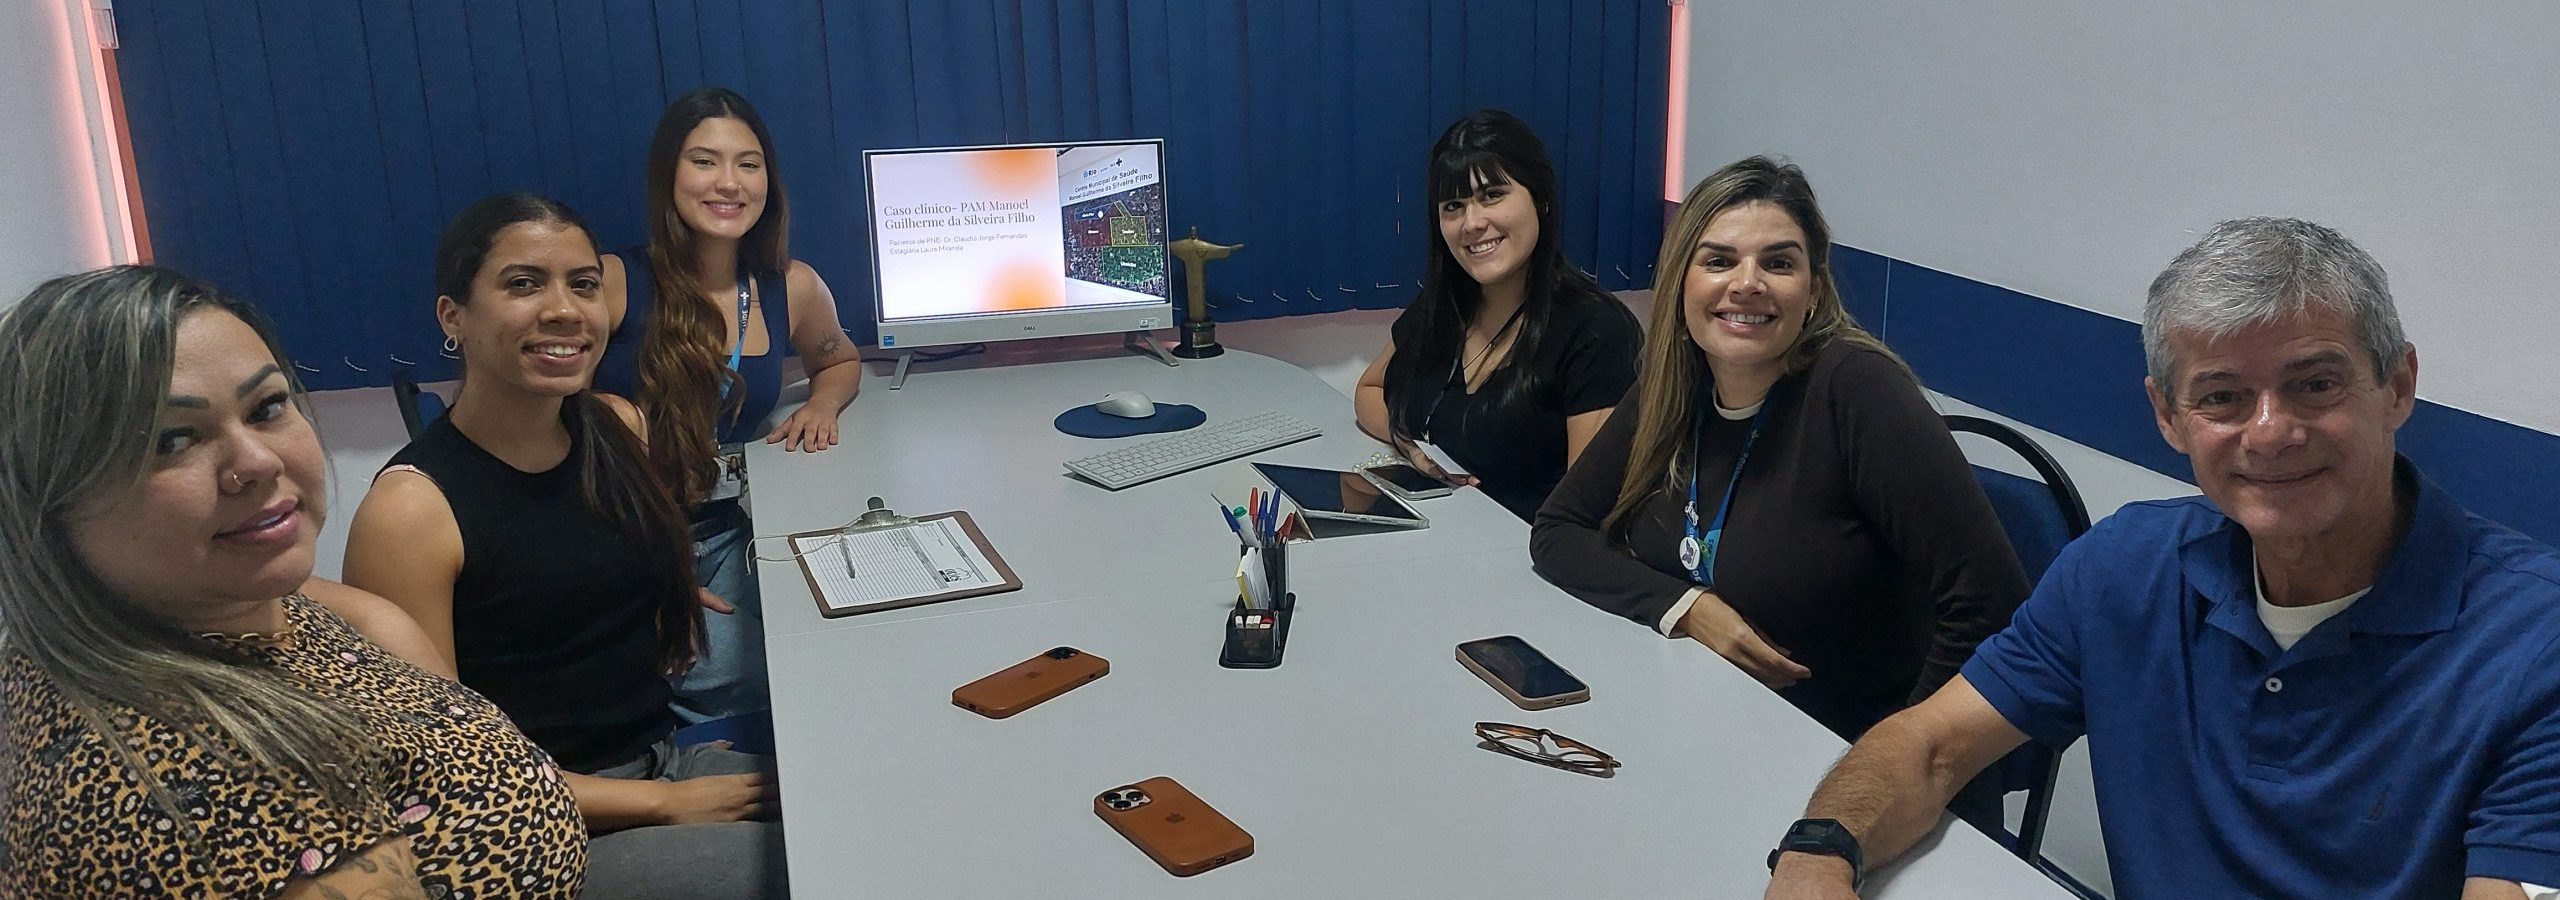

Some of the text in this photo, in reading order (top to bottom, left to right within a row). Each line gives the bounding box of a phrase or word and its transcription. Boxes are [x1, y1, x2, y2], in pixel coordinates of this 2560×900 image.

[1112, 178, 1134, 190] Silveira
[1135, 173, 1153, 183] Filho
[1119, 168, 1138, 179] Saúde
[884, 205, 912, 217] Caso
[961, 201, 986, 213] PAM
[988, 199, 1029, 212] Manoel
[885, 212, 1036, 230] Guilherme da Silveira Filho
[979, 234, 995, 243] Jorge
